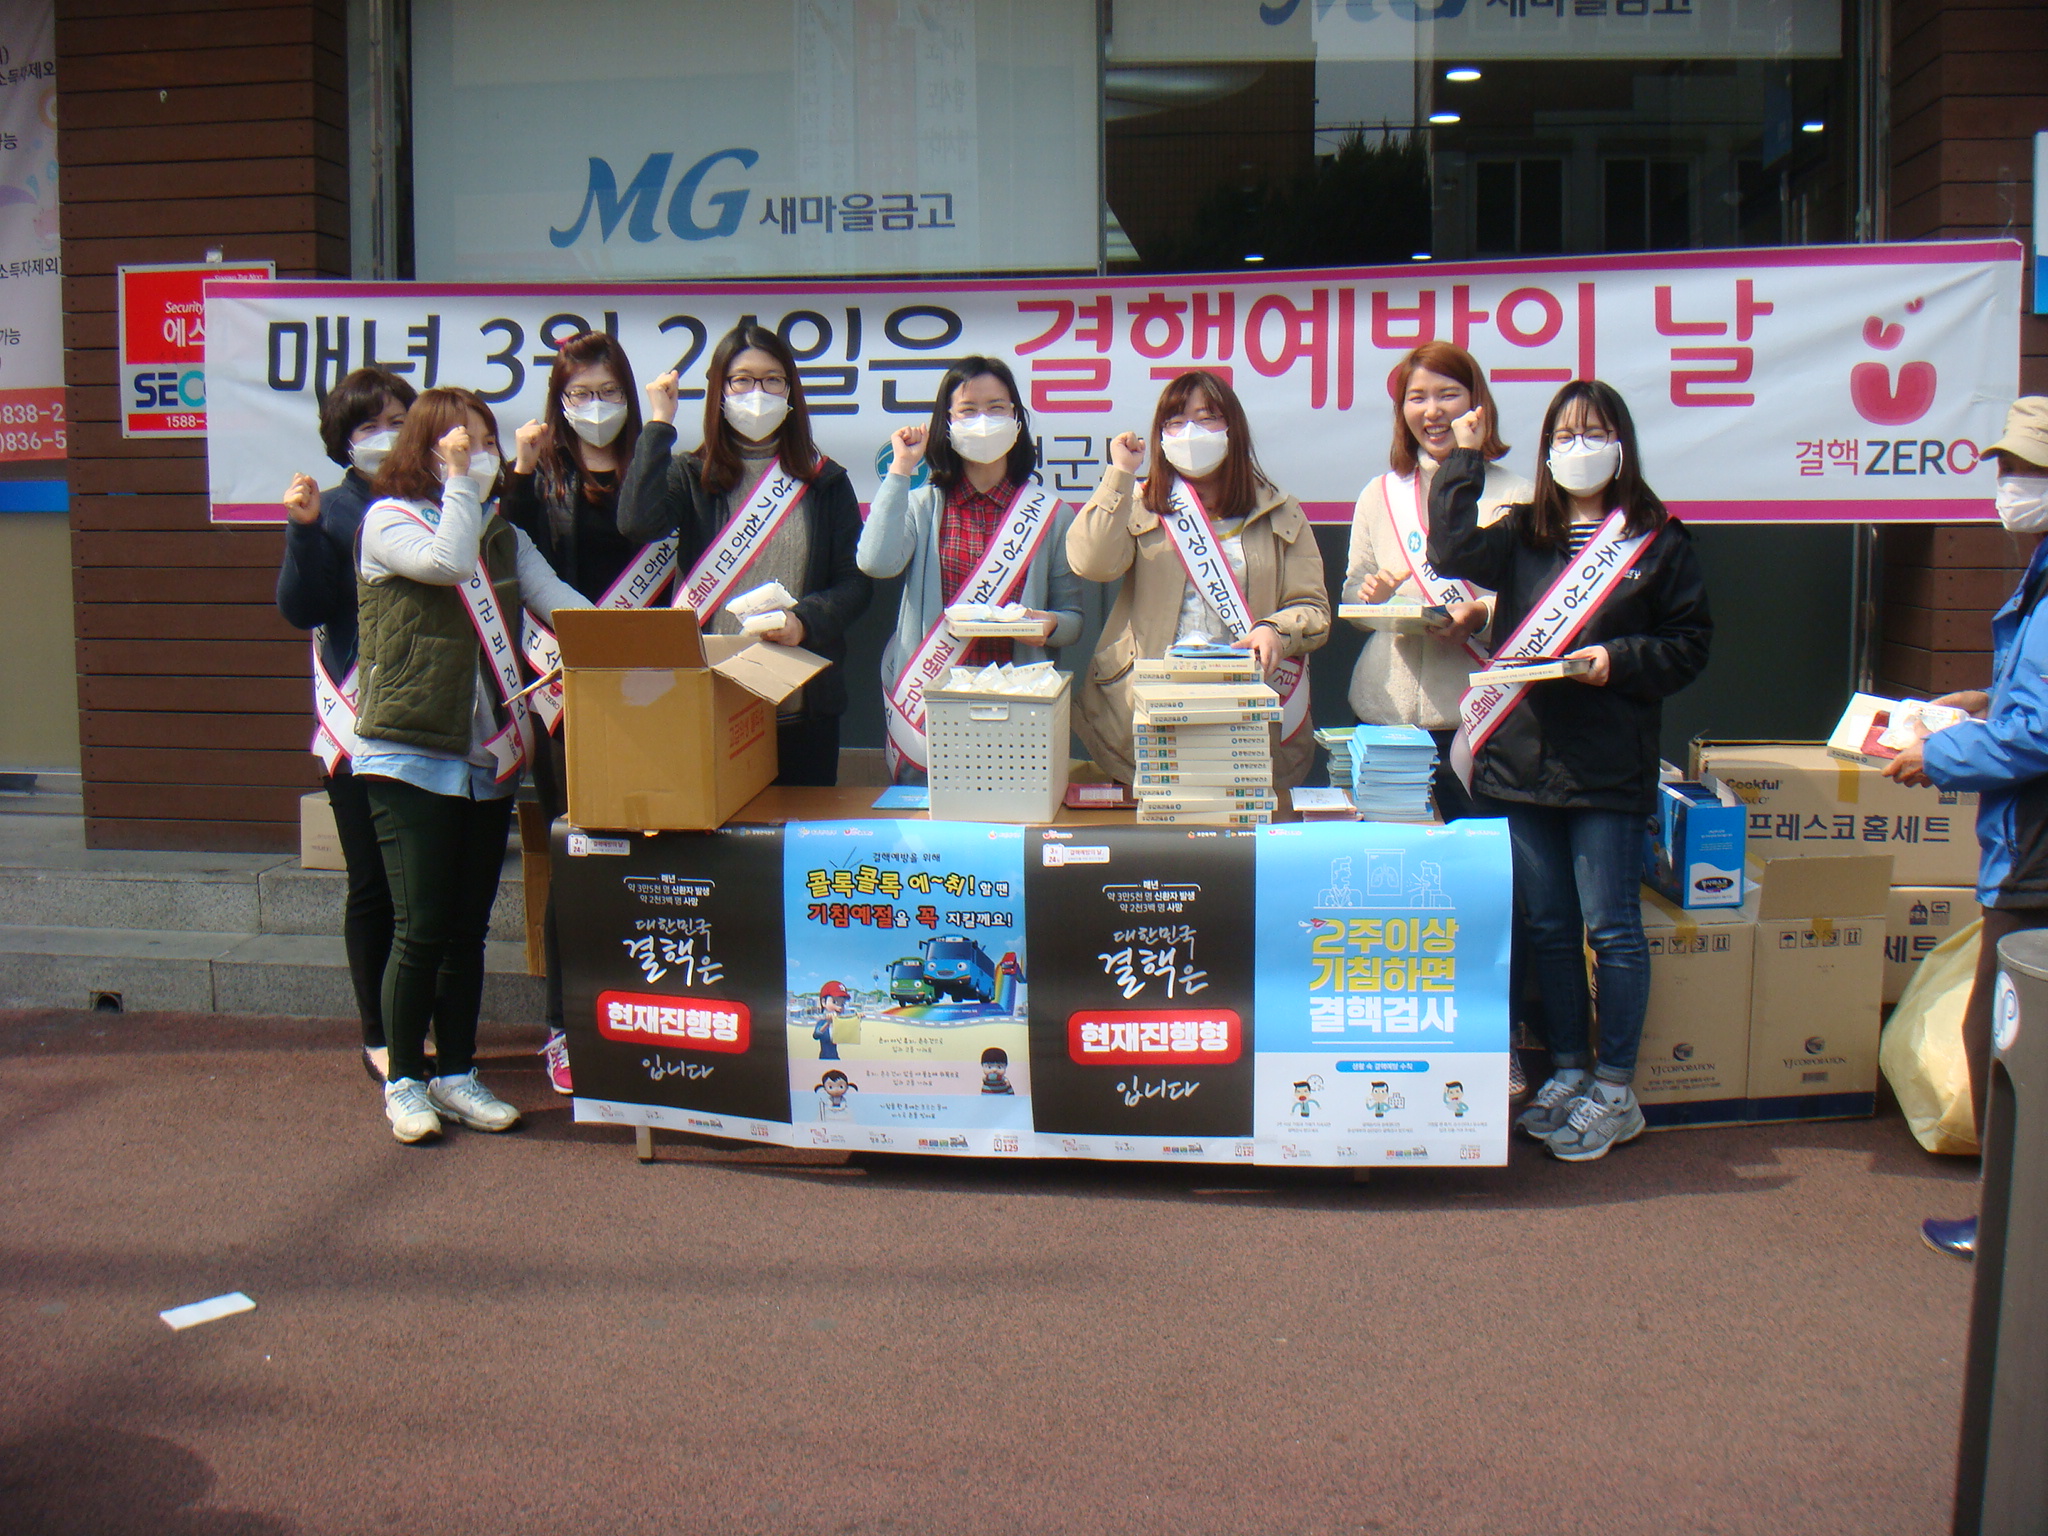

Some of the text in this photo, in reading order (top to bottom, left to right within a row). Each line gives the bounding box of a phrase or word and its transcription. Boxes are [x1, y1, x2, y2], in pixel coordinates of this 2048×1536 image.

[549, 147, 759, 248] MG
[760, 193, 956, 235] 새마을금고
[268, 314, 441, 412] 매년
[657, 305, 964, 416] 2일은
[1014, 282, 1596, 413] 결핵예방의
[1654, 279, 1774, 407] 날
[134, 370, 207, 408] SEC
[166, 415, 208, 428] 1588-
[1796, 438, 1979, 476] 결핵 ZERO
[714, 496, 778, 576] 기침하면
[1002, 491, 1047, 562] 2주이상
[1726, 778, 1779, 790] Cookful
[806, 864, 903, 899] 콜록콜록
[635, 917, 712, 952] 대한민국
[808, 903, 910, 929] 기침예절을
[915, 905, 939, 930] 꼭
[1113, 924, 1197, 960] 대한민국
[1311, 917, 1460, 954] 2주이상
[622, 935, 725, 987] 결핵은
[1097, 947, 1209, 1000] 결핵은
[1309, 956, 1457, 992] 기침하면
[607, 1002, 739, 1042] 현재진행형
[1309, 996, 1459, 1033] 결핵검사
[1080, 1020, 1229, 1053] 현재진행형
[642, 1054, 715, 1081] 입니다
[1116, 1075, 1200, 1107] 입니다
[1003, 1144, 1019, 1152] 129
